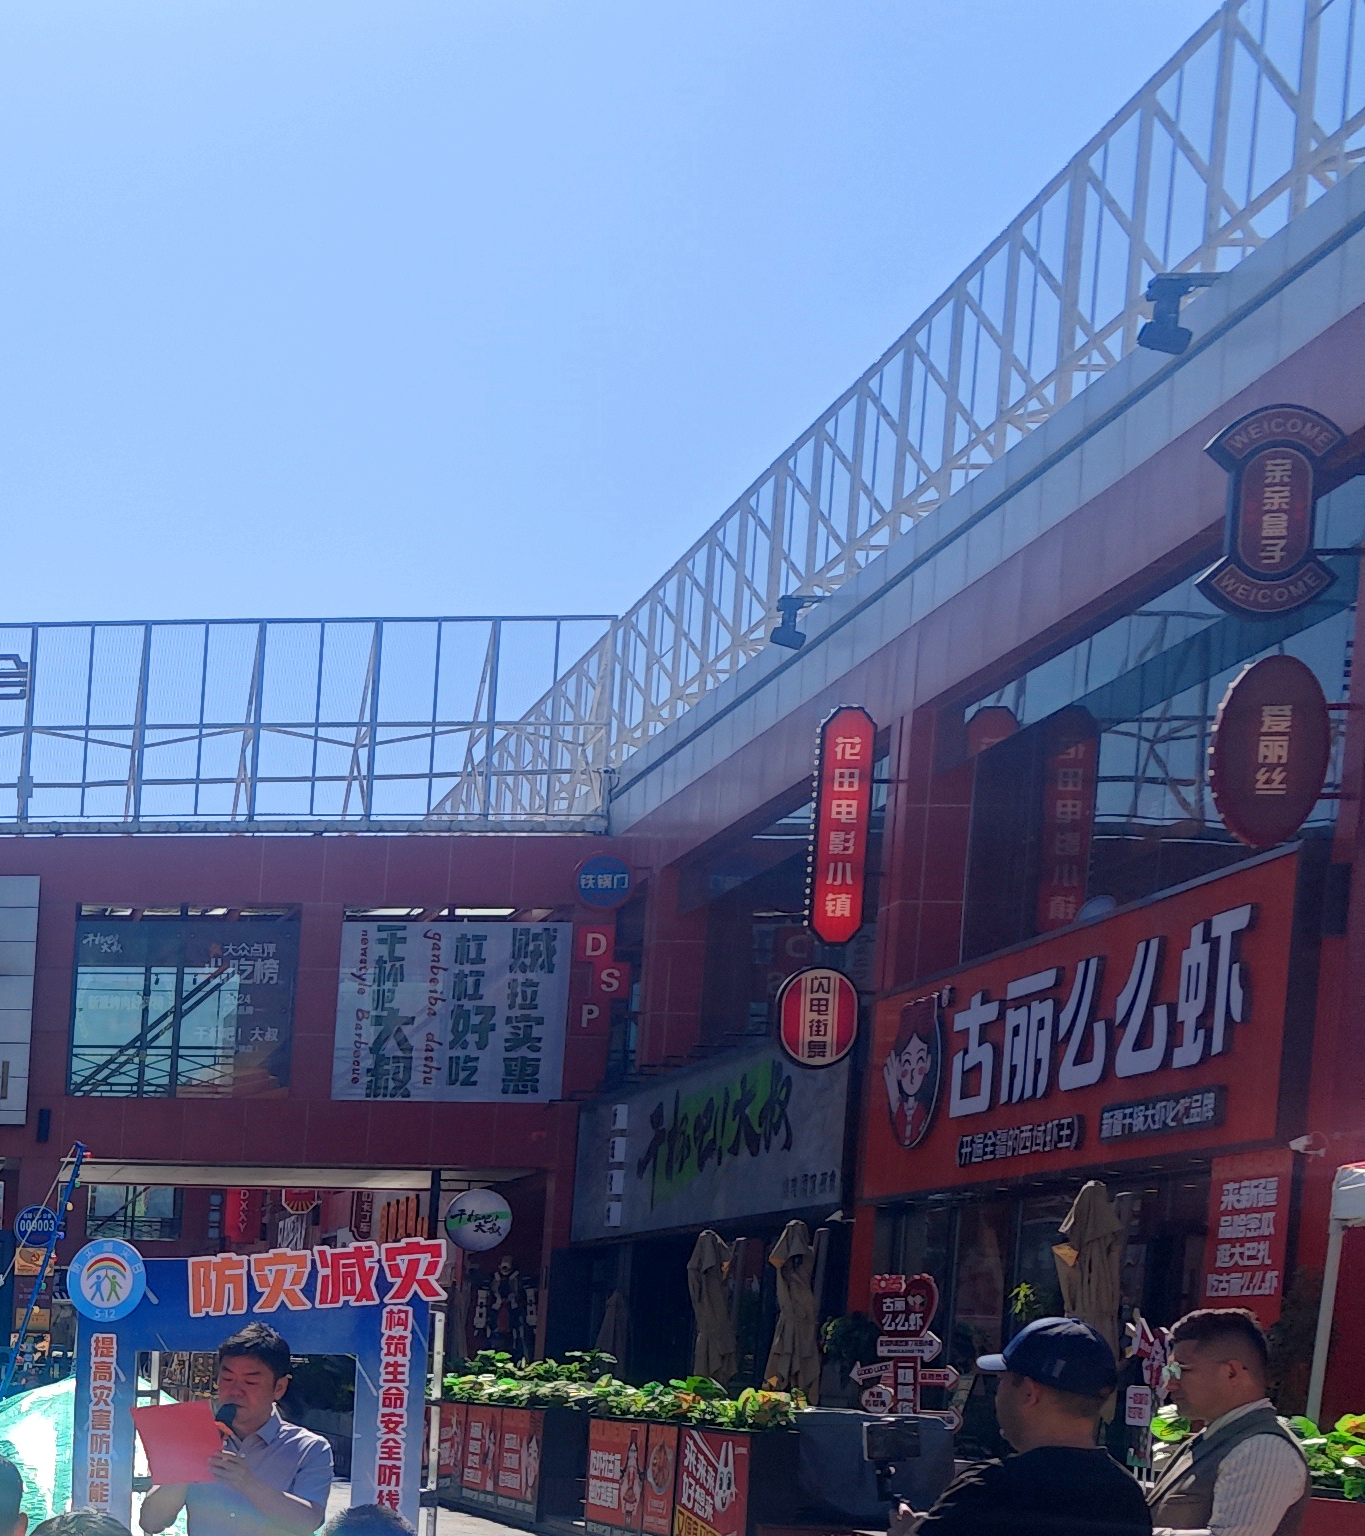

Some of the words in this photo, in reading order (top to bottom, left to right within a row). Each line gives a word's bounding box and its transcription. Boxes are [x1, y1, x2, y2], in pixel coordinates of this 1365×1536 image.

[1254, 704, 1293, 796] 爱丽丝
[825, 736, 862, 919] 花田电影小镇
[223, 943, 277, 957] 大众点评
[446, 933, 496, 1088] 杠杠好吃
[500, 927, 557, 1095] 贼拉实惠
[948, 902, 1253, 1119] 古丽么么虾
[422, 1032, 444, 1086] dashu
[1219, 1177, 1279, 1211] 来新疆
[1217, 1211, 1276, 1240] 品哈密瓜
[188, 1238, 449, 1316] 防灾减灾
[1214, 1240, 1272, 1269] 逛大巴扎
[882, 1297, 906, 1312] 古丽
[1205, 1270, 1279, 1298] 吃古丽么么虾
[881, 1312, 924, 1331] 么么虾
[376, 1305, 413, 1511] 构筑生命安全防线
[684, 1436, 716, 1493] 来来来
[680, 1472, 715, 1523] 好想来
